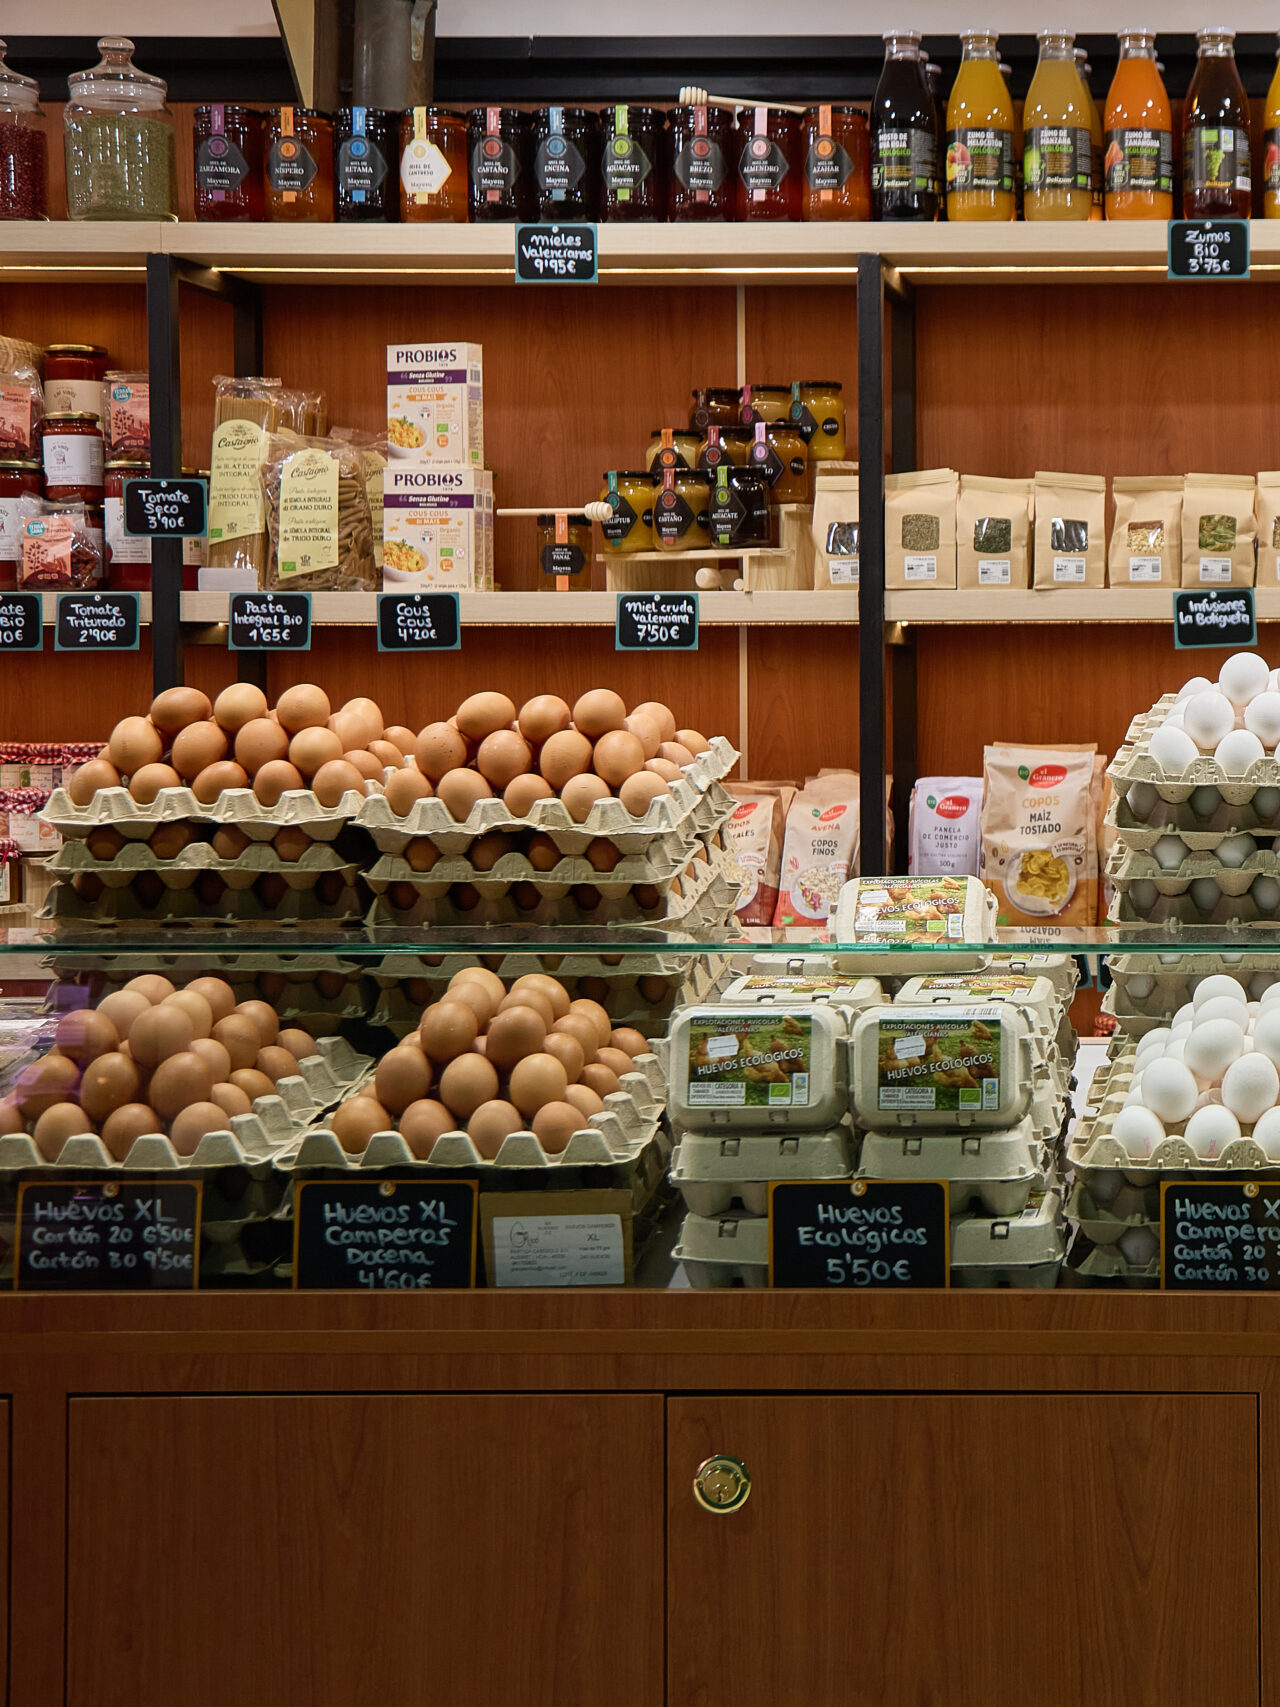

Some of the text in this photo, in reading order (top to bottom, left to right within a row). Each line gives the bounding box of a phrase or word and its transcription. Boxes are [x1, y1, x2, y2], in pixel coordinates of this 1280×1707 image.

[967, 131, 995, 139] ZUMO DE
[1040, 129, 1068, 137] ZUMO DE
[1125, 131, 1152, 139] ZUMO DE
[1040, 137, 1072, 145] MANZANA
[345, 166, 374, 174] RETAMA
[477, 165, 509, 174] CASTAÑO
[544, 165, 570, 173] ENCINA
[606, 164, 640, 172] AGUACATE
[1184, 229, 1231, 243] Zumos
[396, 349, 457, 363] PROBIOS
[409, 372, 425, 380] Senza
[218, 437, 259, 450] Castagno
[290, 466, 329, 480] Castagno
[394, 473, 463, 487] PROBIOS
[137, 489, 191, 504] Tomate
[427, 495, 450, 503] Glutine
[144, 502, 179, 514] Seco
[70, 603, 122, 617] Tomate
[245, 600, 287, 615] Pasta
[396, 603, 431, 617] Cous
[660, 599, 695, 614] cruda
[1188, 598, 1247, 613] Infusiones
[66, 616, 126, 628] Triturado
[234, 611, 280, 628] Integral
[397, 616, 433, 628] Cous
[1179, 611, 1194, 625] La
[1032, 774, 1063, 782] Granero
[939, 803, 967, 812] Granero
[1022, 795, 1060, 809] COPOS
[1029, 809, 1052, 823] MAÍZ
[810, 823, 841, 832] AVENA
[934, 826, 961, 834] PANELA
[1020, 823, 1062, 836] TOSTADO
[811, 839, 839, 848] COPOS
[934, 833, 970, 841] COMERCIO
[812, 848, 836, 856] FINOS
[936, 841, 958, 849] JUSTO
[693, 1018, 746, 1026] EXPLOTACIONES
[697, 1047, 804, 1076] HUEVOS ECOLOGICOS
[887, 1052, 993, 1080] HUEVOS ECOLOGICOS
[34, 1199, 178, 1223] Huevos XL
[323, 1200, 458, 1226] Huevos XL
[817, 1203, 904, 1225] Huevos
[1174, 1198, 1252, 1221] Huevos
[32, 1225, 100, 1245] Cartón
[109, 1226, 133, 1245] 20
[325, 1225, 452, 1248] Camperos
[586, 1233, 600, 1242] XL
[797, 1226, 928, 1254] Ecológicos
[346, 1247, 435, 1265] Docena
[1173, 1242, 1233, 1261] Cartón
[1243, 1244, 1266, 1261] 20
[28, 1250, 100, 1270] Cartón
[109, 1251, 137, 1269] 30
[1174, 1263, 1239, 1282] Cartón
[1244, 1266, 1270, 1281] 30
